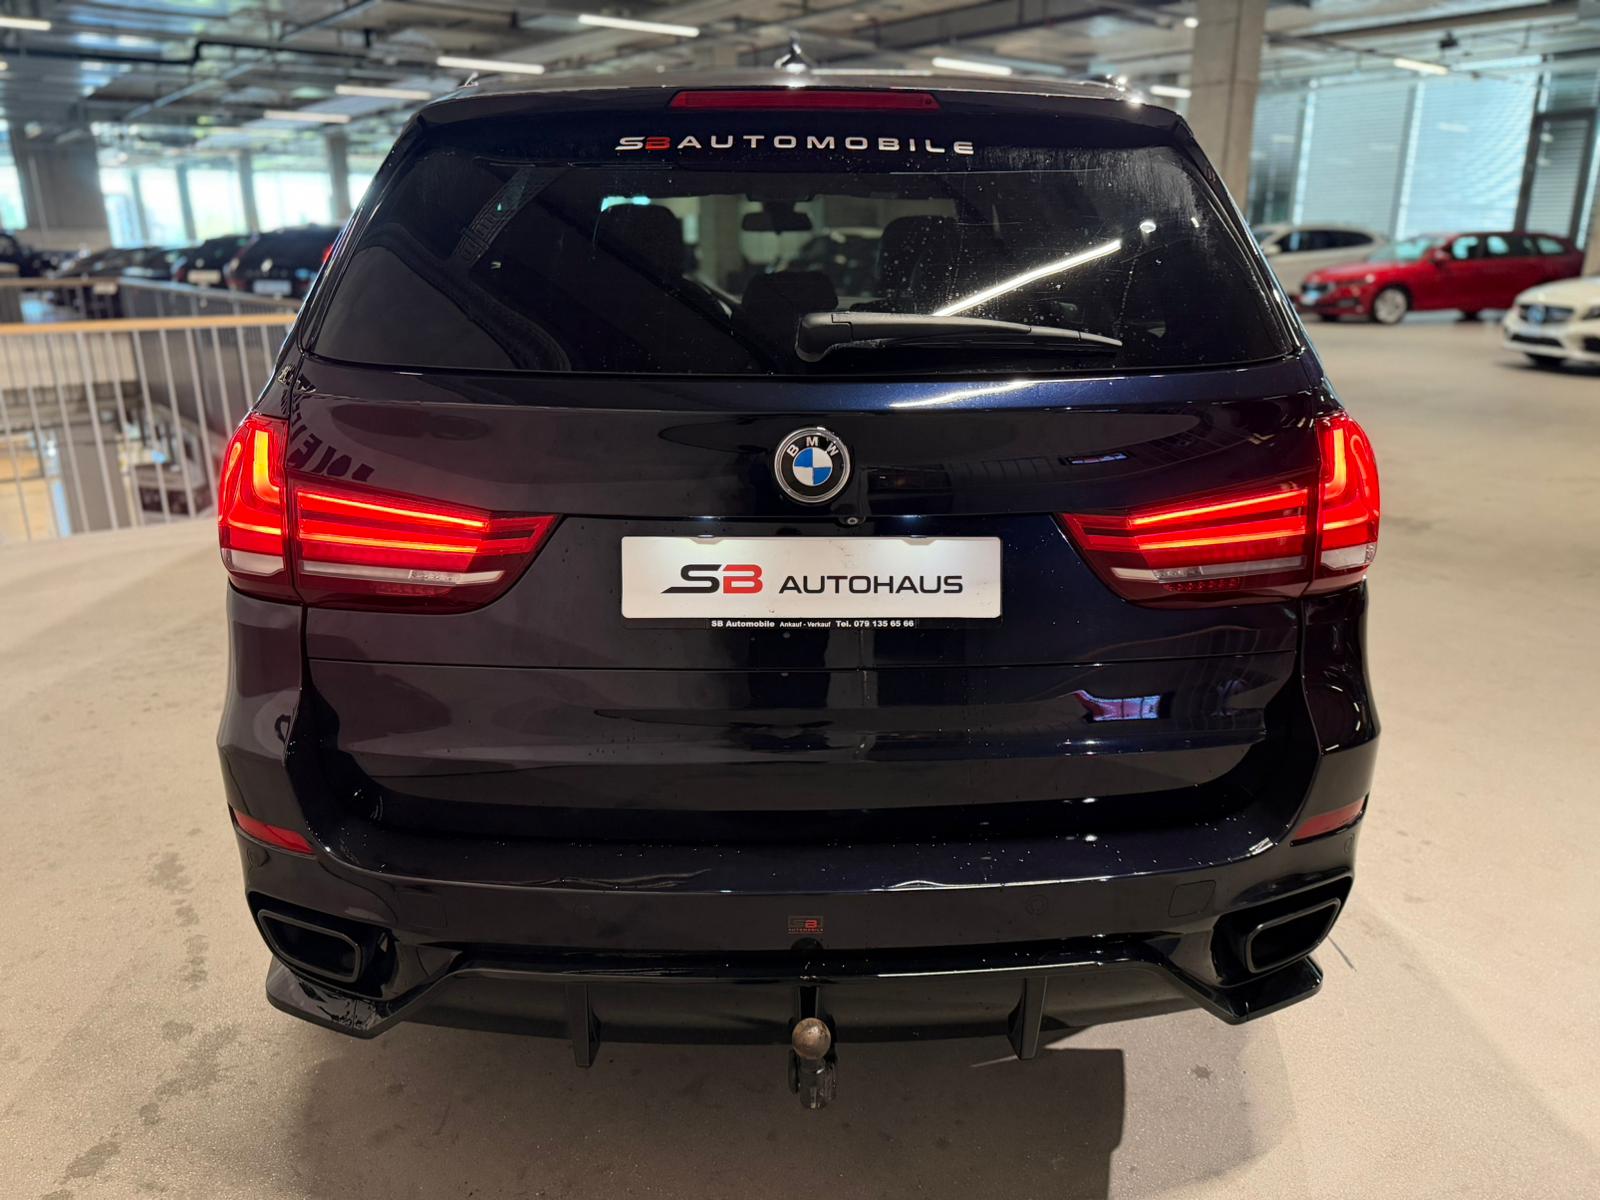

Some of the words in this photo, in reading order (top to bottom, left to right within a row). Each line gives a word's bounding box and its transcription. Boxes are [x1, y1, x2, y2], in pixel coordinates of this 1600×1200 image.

[615, 136, 671, 150] SB
[677, 136, 975, 155] AUTOMOBILE
[786, 436, 839, 457] BMW
[661, 564, 763, 594] SB
[779, 575, 964, 594] AUTOHAUS
[711, 620, 724, 628] SB
[726, 620, 775, 628] Automobile
[836, 620, 851, 628] Tel.
[853, 620, 870, 628] 079
[872, 620, 888, 628] 135
[890, 620, 902, 628] 65
[903, 620, 914, 628] 66
